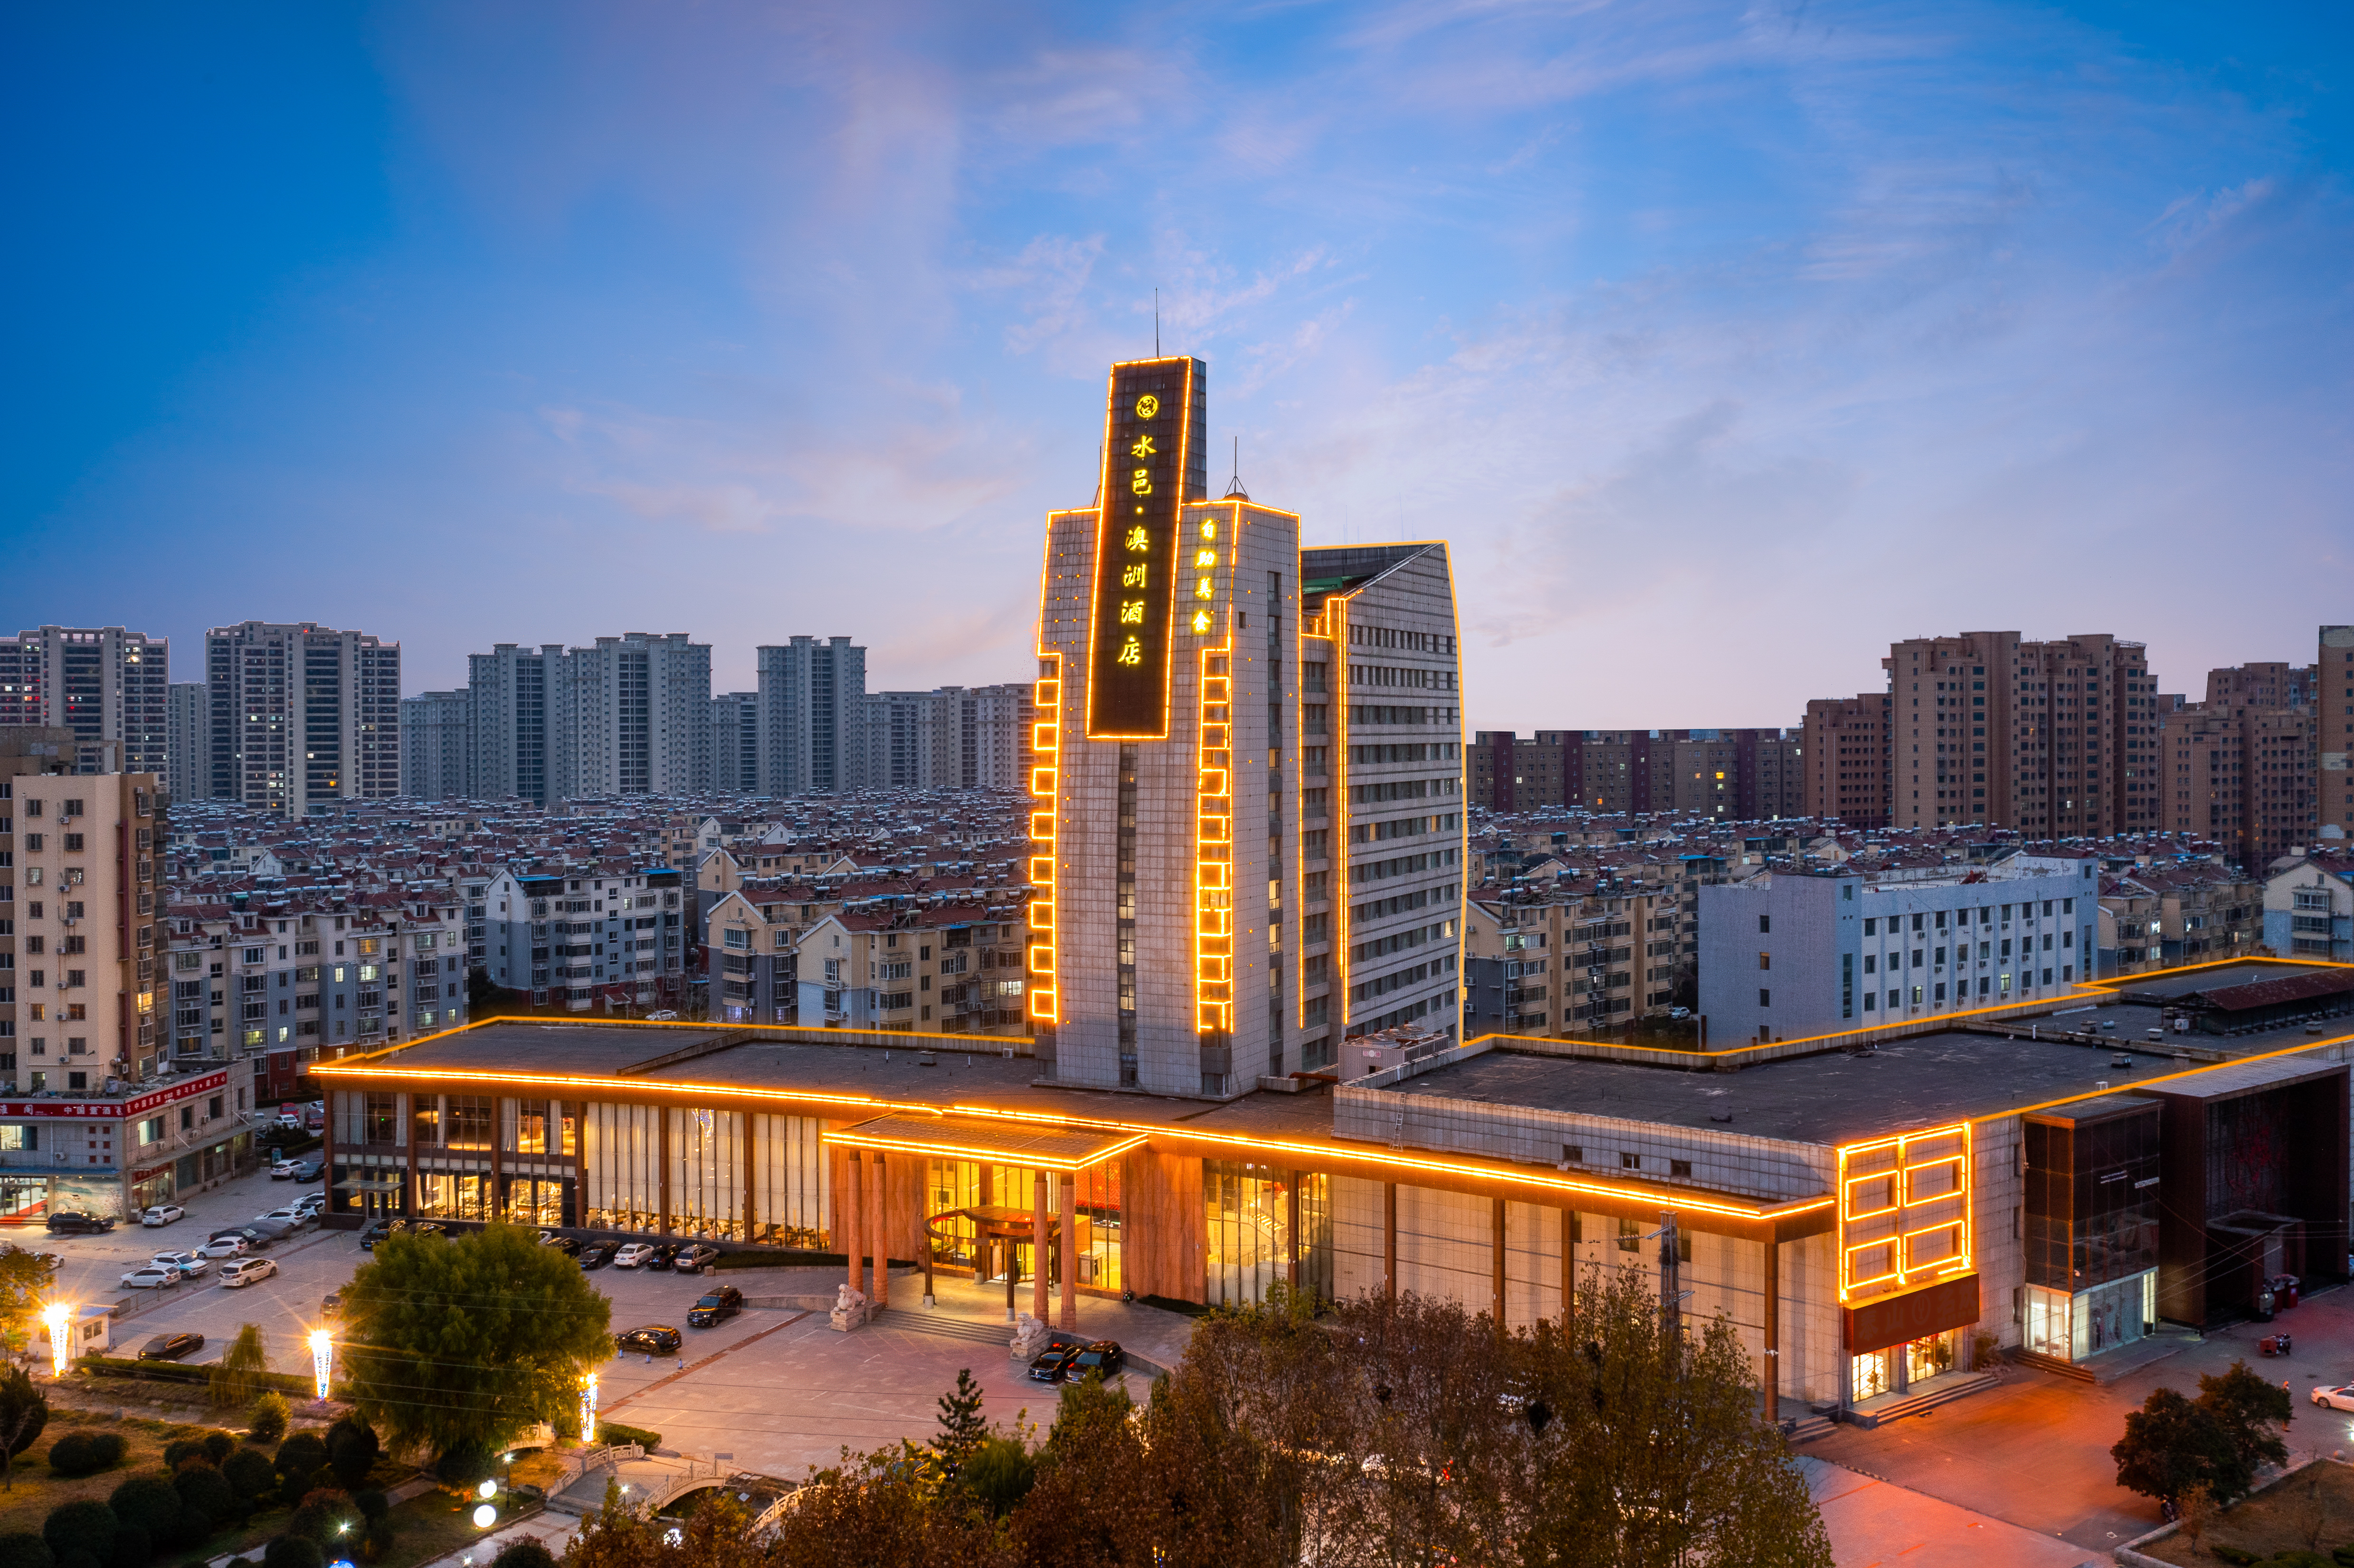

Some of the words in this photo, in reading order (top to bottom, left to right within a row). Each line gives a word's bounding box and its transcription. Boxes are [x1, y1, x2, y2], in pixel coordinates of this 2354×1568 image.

[1118, 435, 1157, 665] 水邑·澳洲酒店
[1192, 520, 1216, 631] 自助美食
[1859, 1302, 1904, 1341] 泰山
